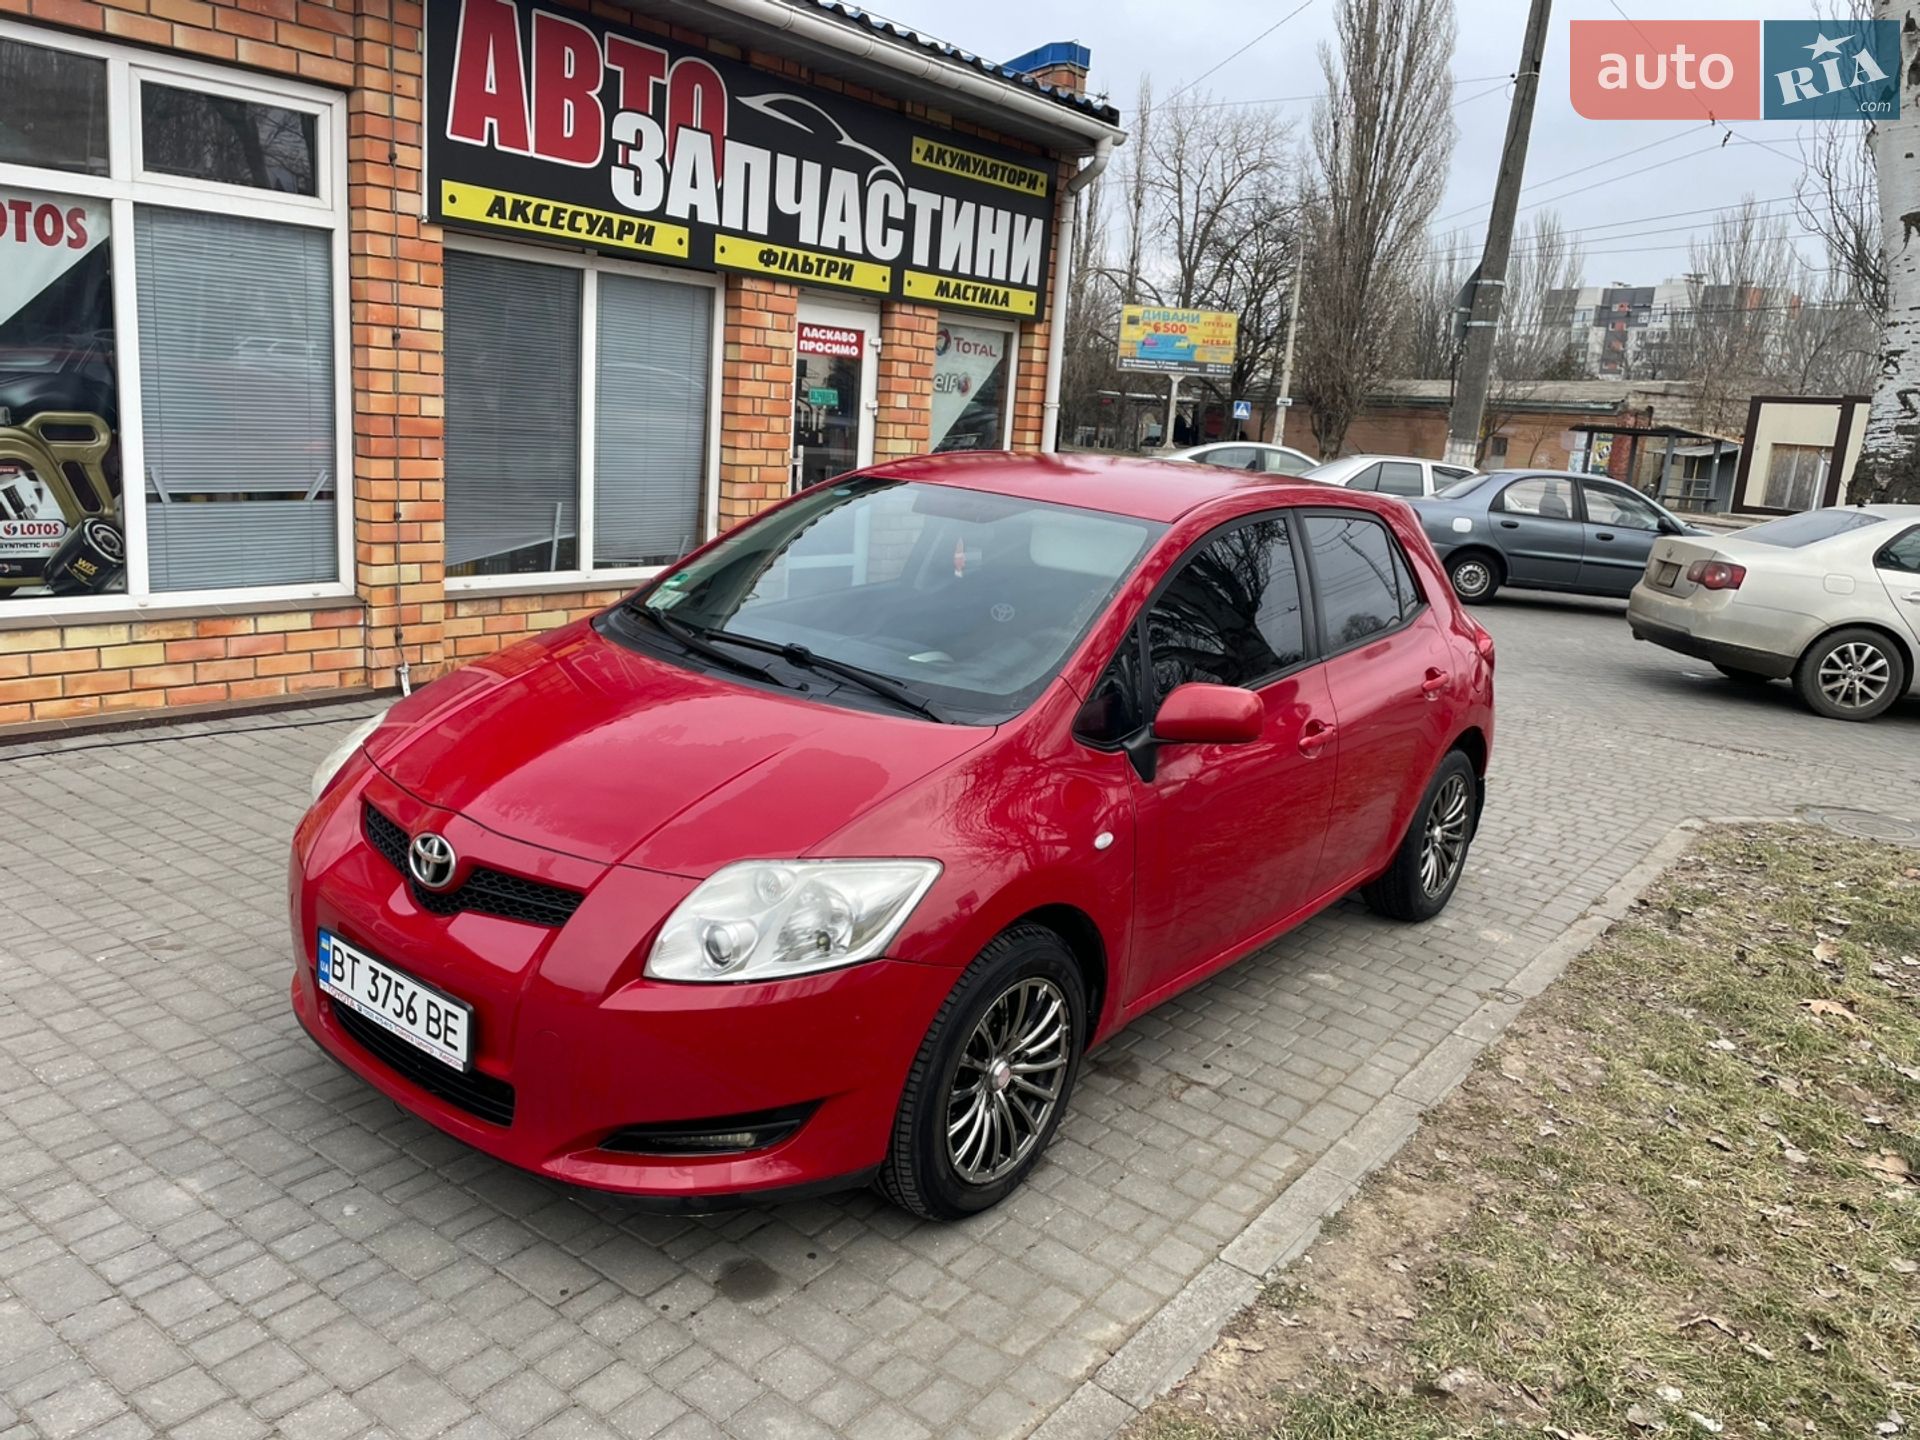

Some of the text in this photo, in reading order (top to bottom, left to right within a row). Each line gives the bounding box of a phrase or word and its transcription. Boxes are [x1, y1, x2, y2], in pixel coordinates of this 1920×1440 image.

[446, 0, 728, 192] АВТО
[922, 144, 1039, 191] АКУМУЛЯТОРИ
[611, 111, 1044, 287] ЗАПЧАСТИНИ
[0, 199, 88, 250] TOS
[486, 195, 656, 247] АКСЕСУАРИ
[758, 248, 854, 282] ФІЛЬТРИ
[935, 280, 1010, 308] МАСТИЛА
[1142, 310, 1199, 323] ДИВАНИ
[1162, 322, 1188, 334] 500
[802, 326, 857, 343] ЛАСКАВО
[953, 336, 997, 357] TOTAL
[799, 340, 859, 356] ПРОСИМО
[933, 372, 960, 394] elf
[21, 523, 59, 535] LOTOS
[320, 961, 329, 974] UA
[332, 943, 360, 990] BT
[367, 965, 418, 1026] 3756
[426, 999, 459, 1052] BE
